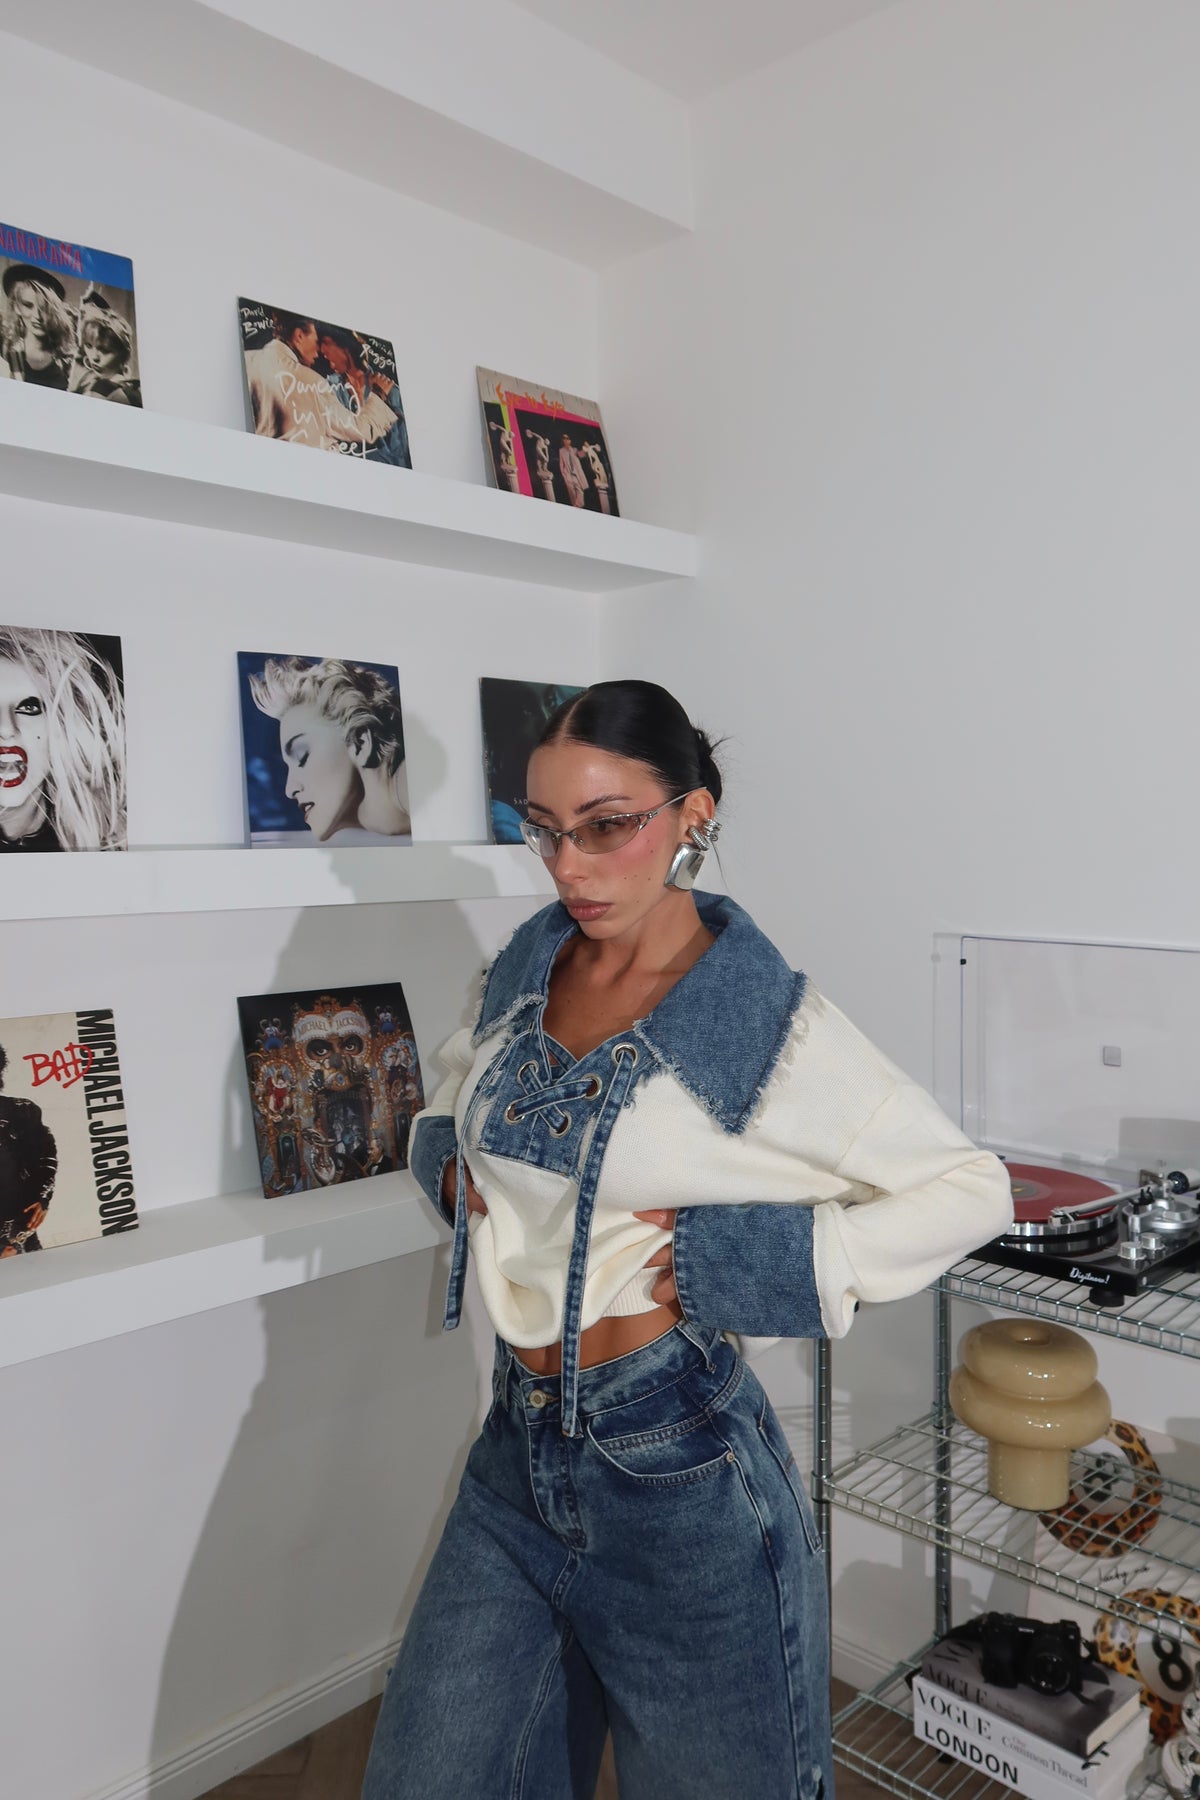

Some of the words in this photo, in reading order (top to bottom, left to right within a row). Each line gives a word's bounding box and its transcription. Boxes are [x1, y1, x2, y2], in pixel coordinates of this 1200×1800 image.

[22, 1042, 94, 1089] BAD
[75, 1009, 125, 1121] MICHAEL
[88, 1118, 139, 1237] JACKSON
[917, 1686, 992, 1740] VOGUE
[924, 1720, 1019, 1785] LONDON
